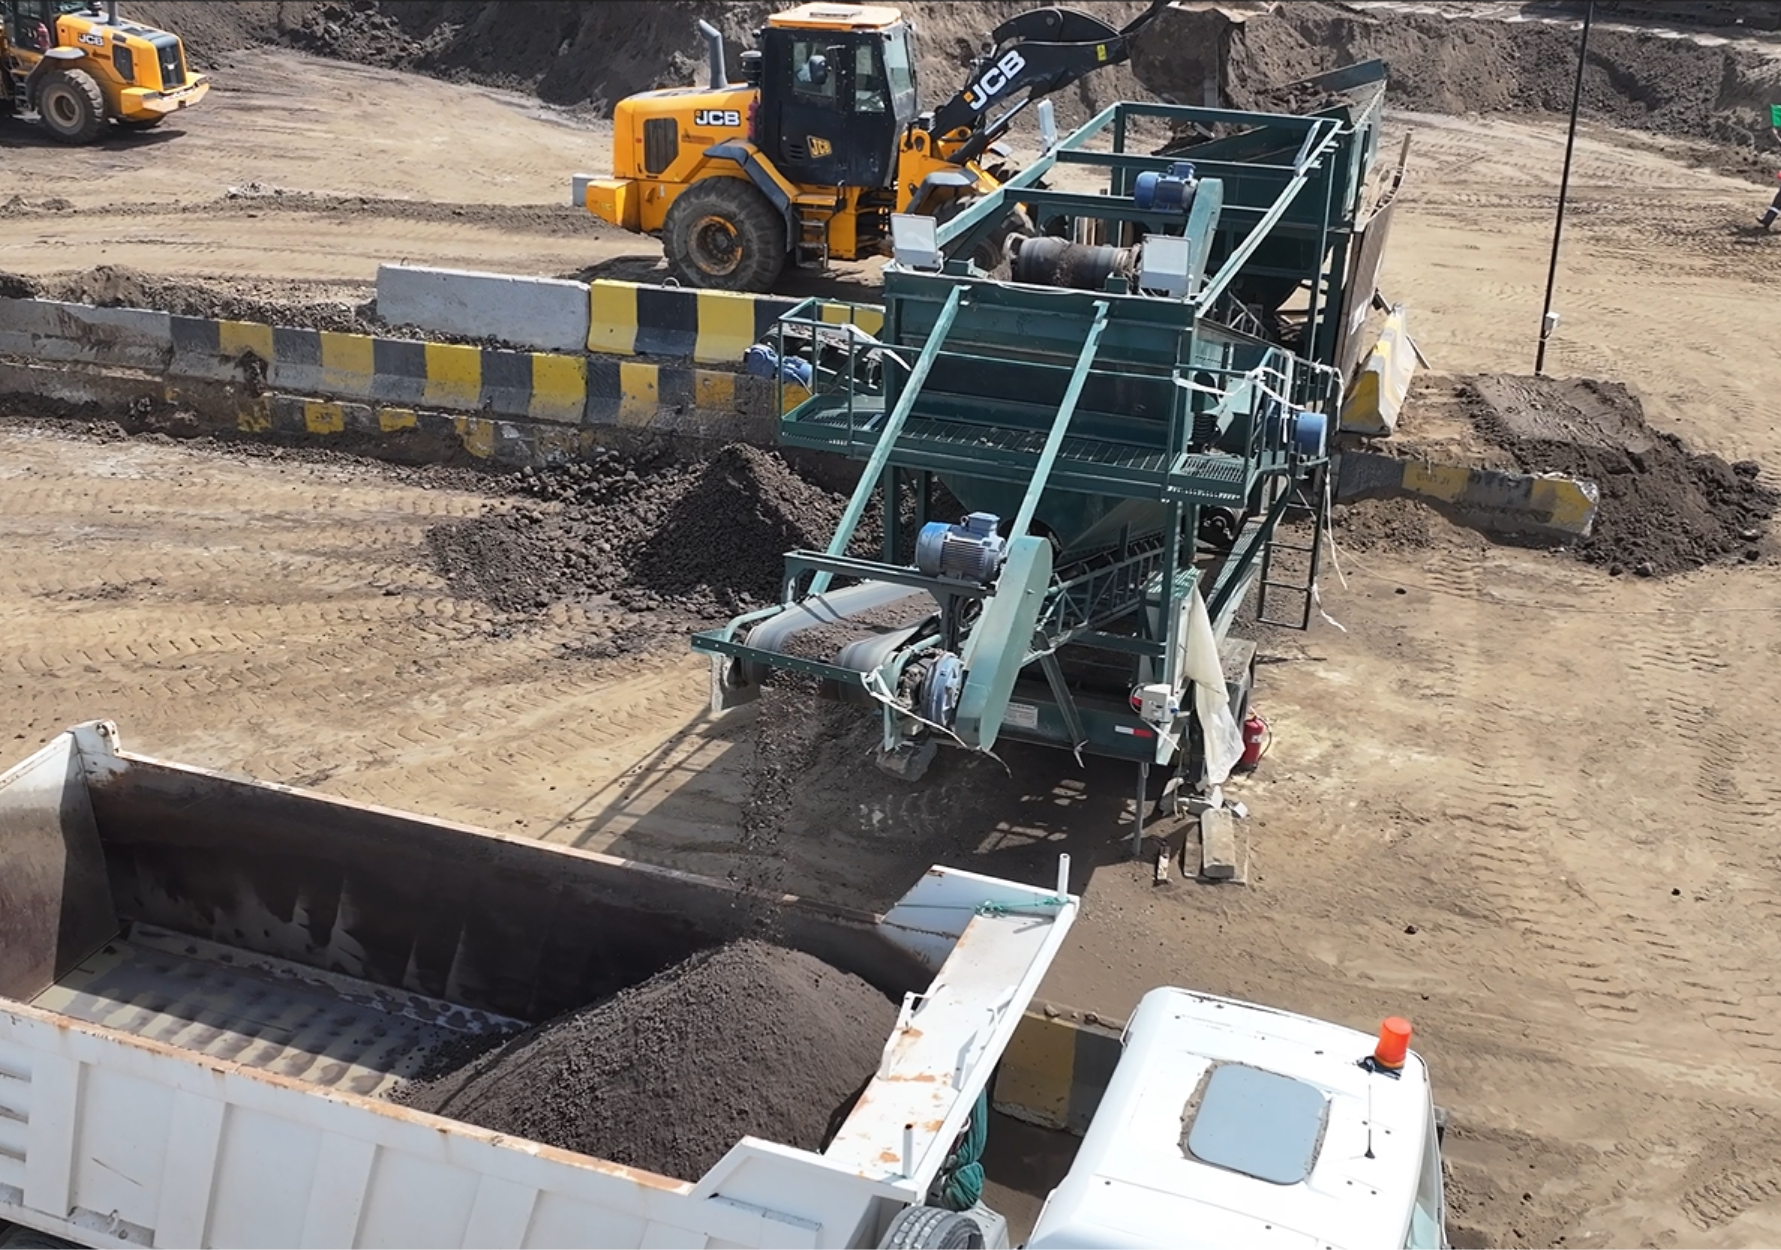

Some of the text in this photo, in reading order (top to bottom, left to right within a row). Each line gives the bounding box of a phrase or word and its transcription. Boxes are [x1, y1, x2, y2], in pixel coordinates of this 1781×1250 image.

[78, 33, 105, 46] JCB
[969, 49, 1027, 111] JCB
[695, 110, 740, 126] JCB
[809, 137, 831, 157] JCB
